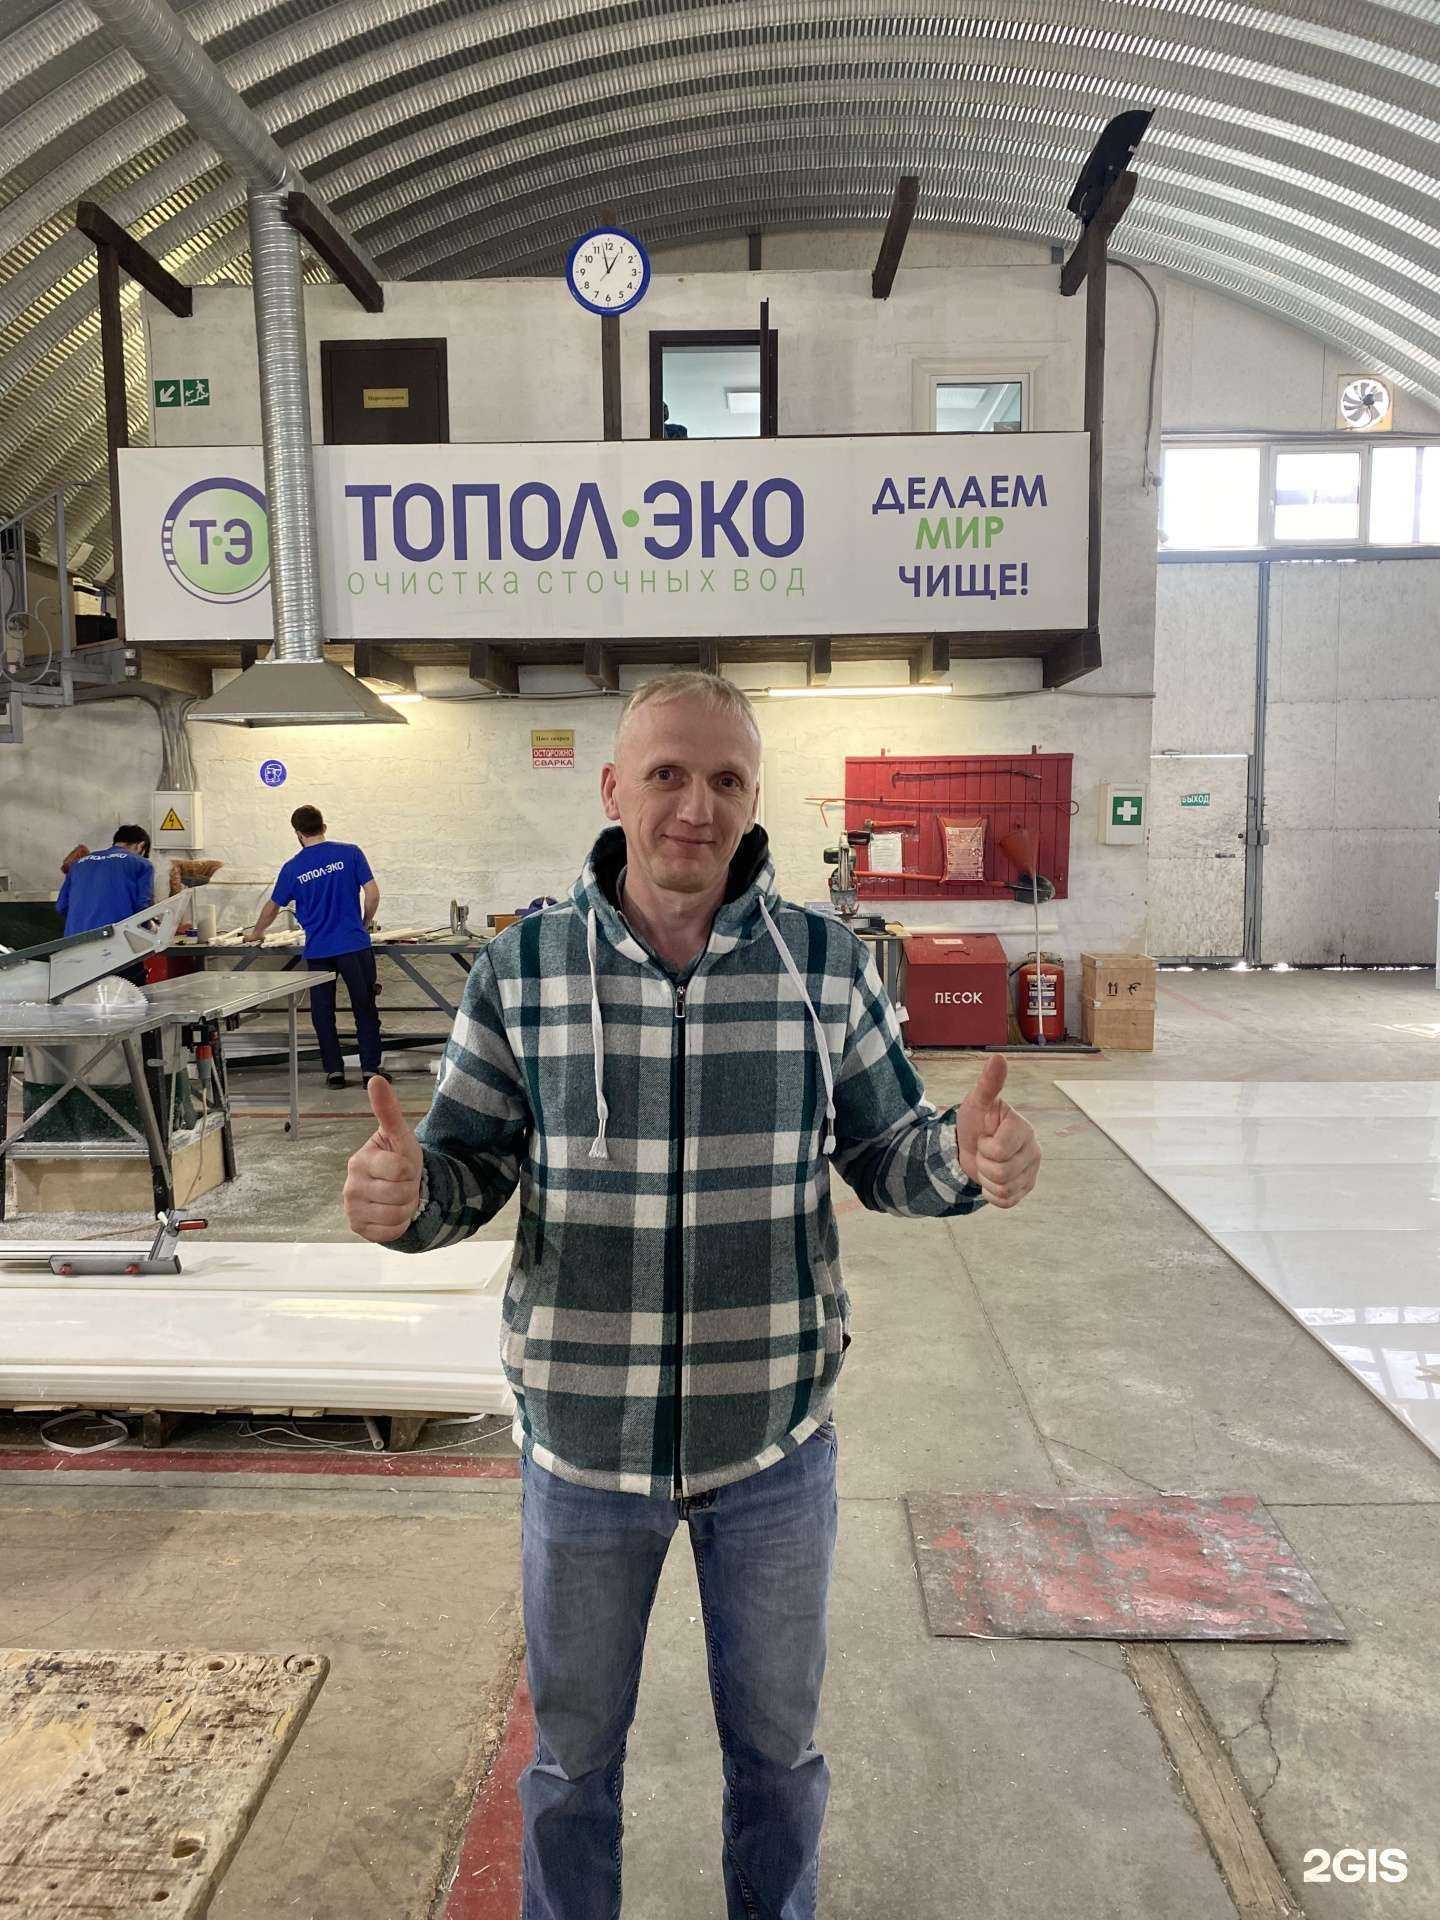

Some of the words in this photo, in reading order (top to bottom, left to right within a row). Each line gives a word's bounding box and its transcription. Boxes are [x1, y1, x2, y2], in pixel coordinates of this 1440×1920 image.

[872, 474, 1048, 516] ДЕЛАЕМ
[915, 515, 1004, 551] МИР
[898, 562, 1030, 601] ЧИЩЕ!
[534, 749, 573, 757] ОСТОРОЖНО
[934, 991, 984, 1004] ПЕСОК
